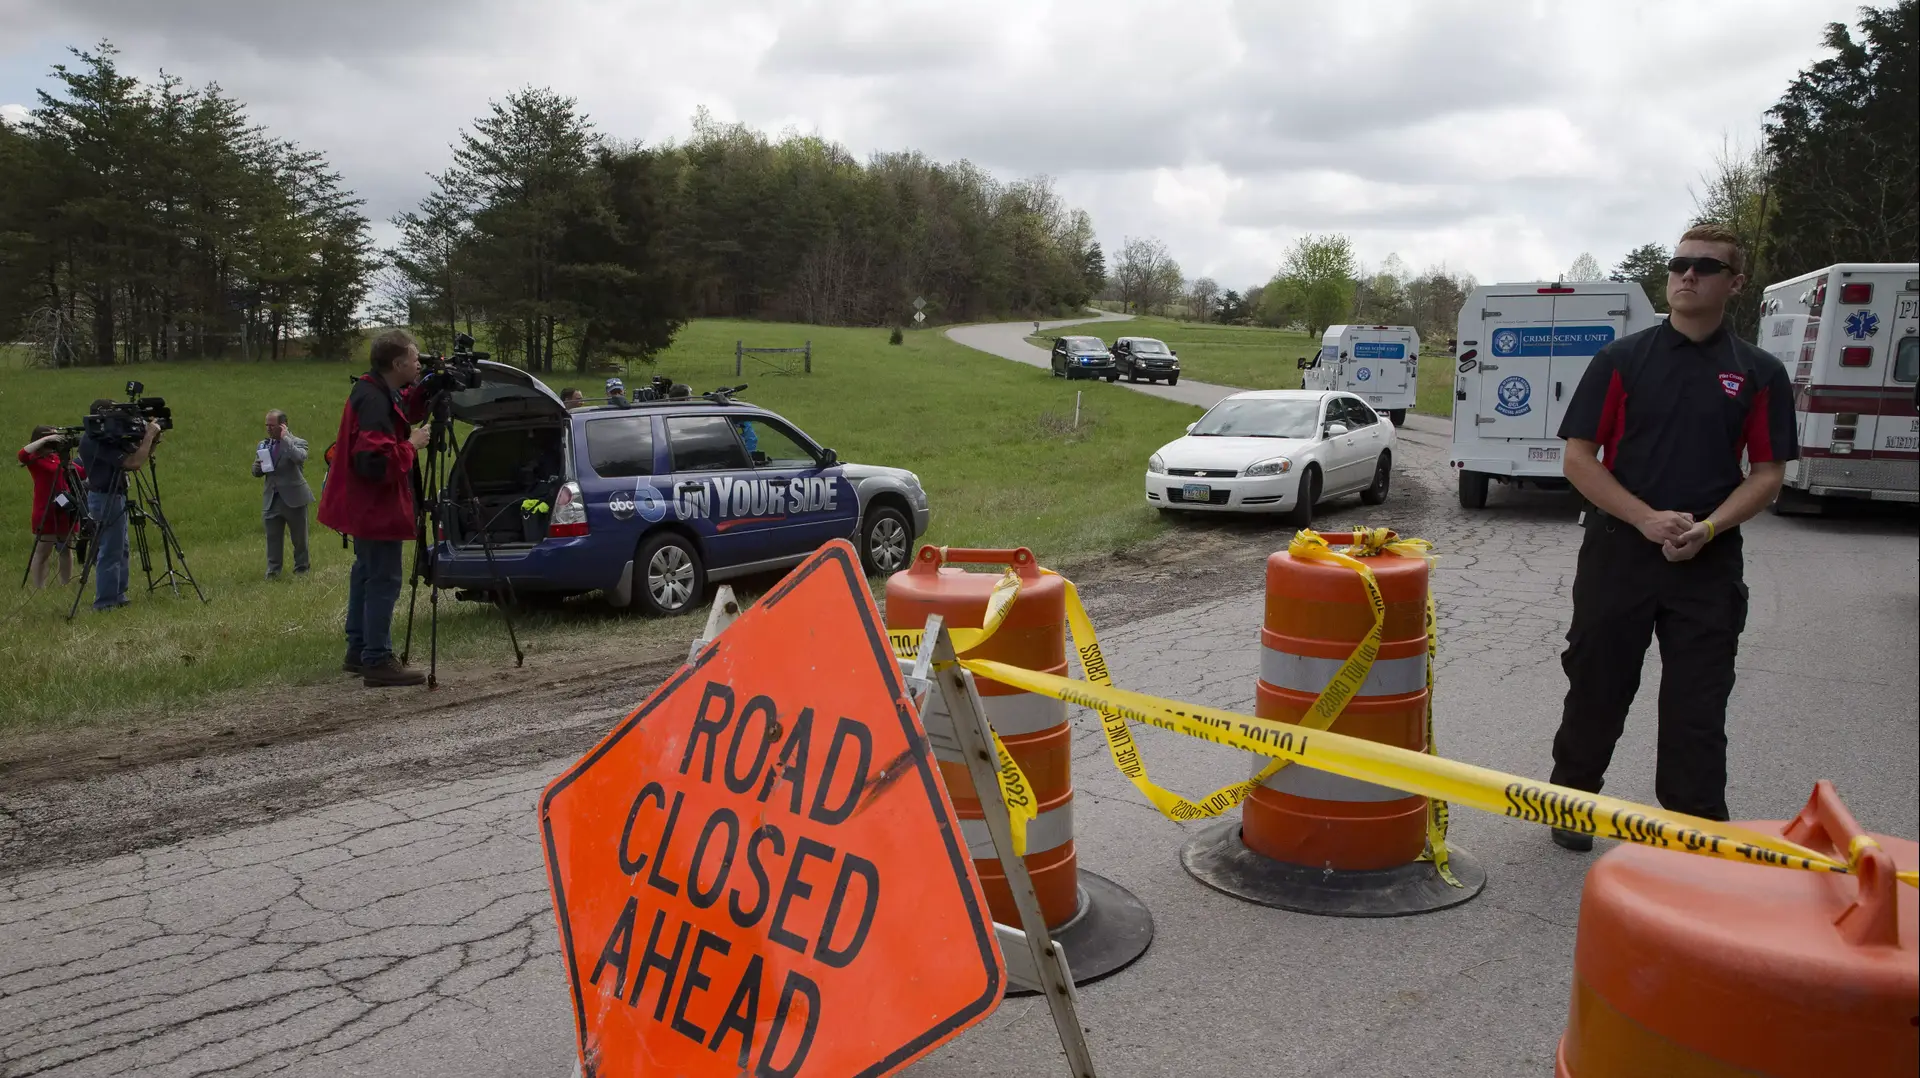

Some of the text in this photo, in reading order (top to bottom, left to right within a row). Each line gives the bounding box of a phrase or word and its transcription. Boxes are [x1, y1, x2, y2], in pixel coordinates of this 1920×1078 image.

[1522, 335, 1552, 343] CRIME
[1553, 333, 1582, 342] SCENE
[1584, 333, 1608, 341] UNIT
[129, 381, 135, 391] 3
[609, 475, 667, 523] abc 6
[673, 476, 838, 521] ON YOUR SIDE
[1080, 643, 1108, 682] CROSS
[680, 680, 873, 826] ROAD
[1107, 723, 1131, 748] LINE
[1211, 793, 1229, 809] DO
[1505, 783, 1597, 834] CROSS
[618, 781, 880, 969] CLOSED
[590, 895, 822, 1078] AHEAD
